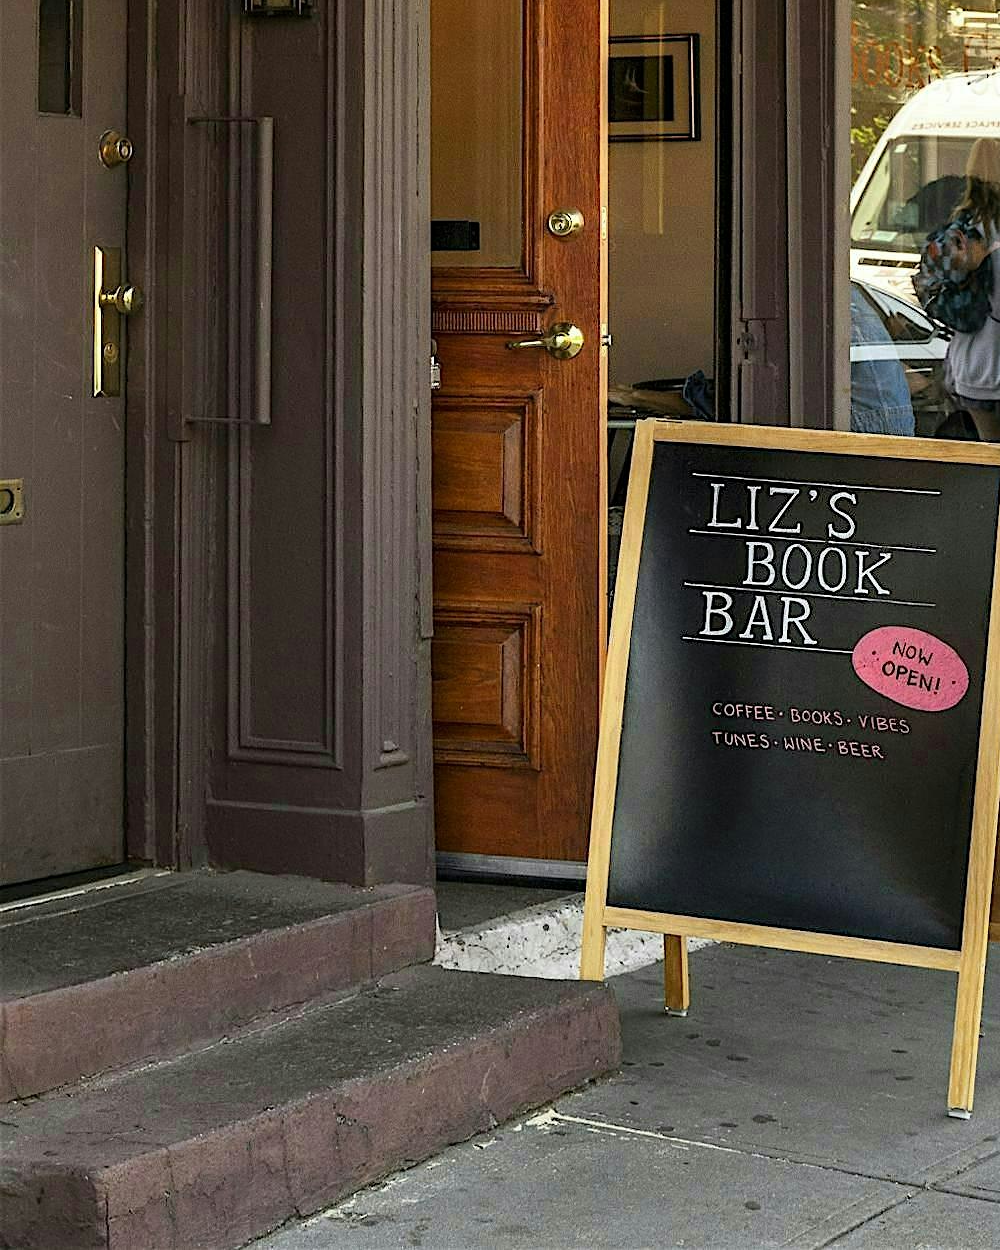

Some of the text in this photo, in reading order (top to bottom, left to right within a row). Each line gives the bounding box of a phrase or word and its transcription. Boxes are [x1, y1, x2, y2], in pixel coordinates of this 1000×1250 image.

[706, 482, 858, 540] LIZ'S
[742, 541, 893, 596] BOOK
[698, 590, 819, 645] BAR
[891, 639, 935, 667] NOW
[881, 660, 942, 695] OPEN!
[711, 701, 911, 735] COFFEE BOOKS VIBES
[711, 730, 886, 760] TUNES WINE BEER
